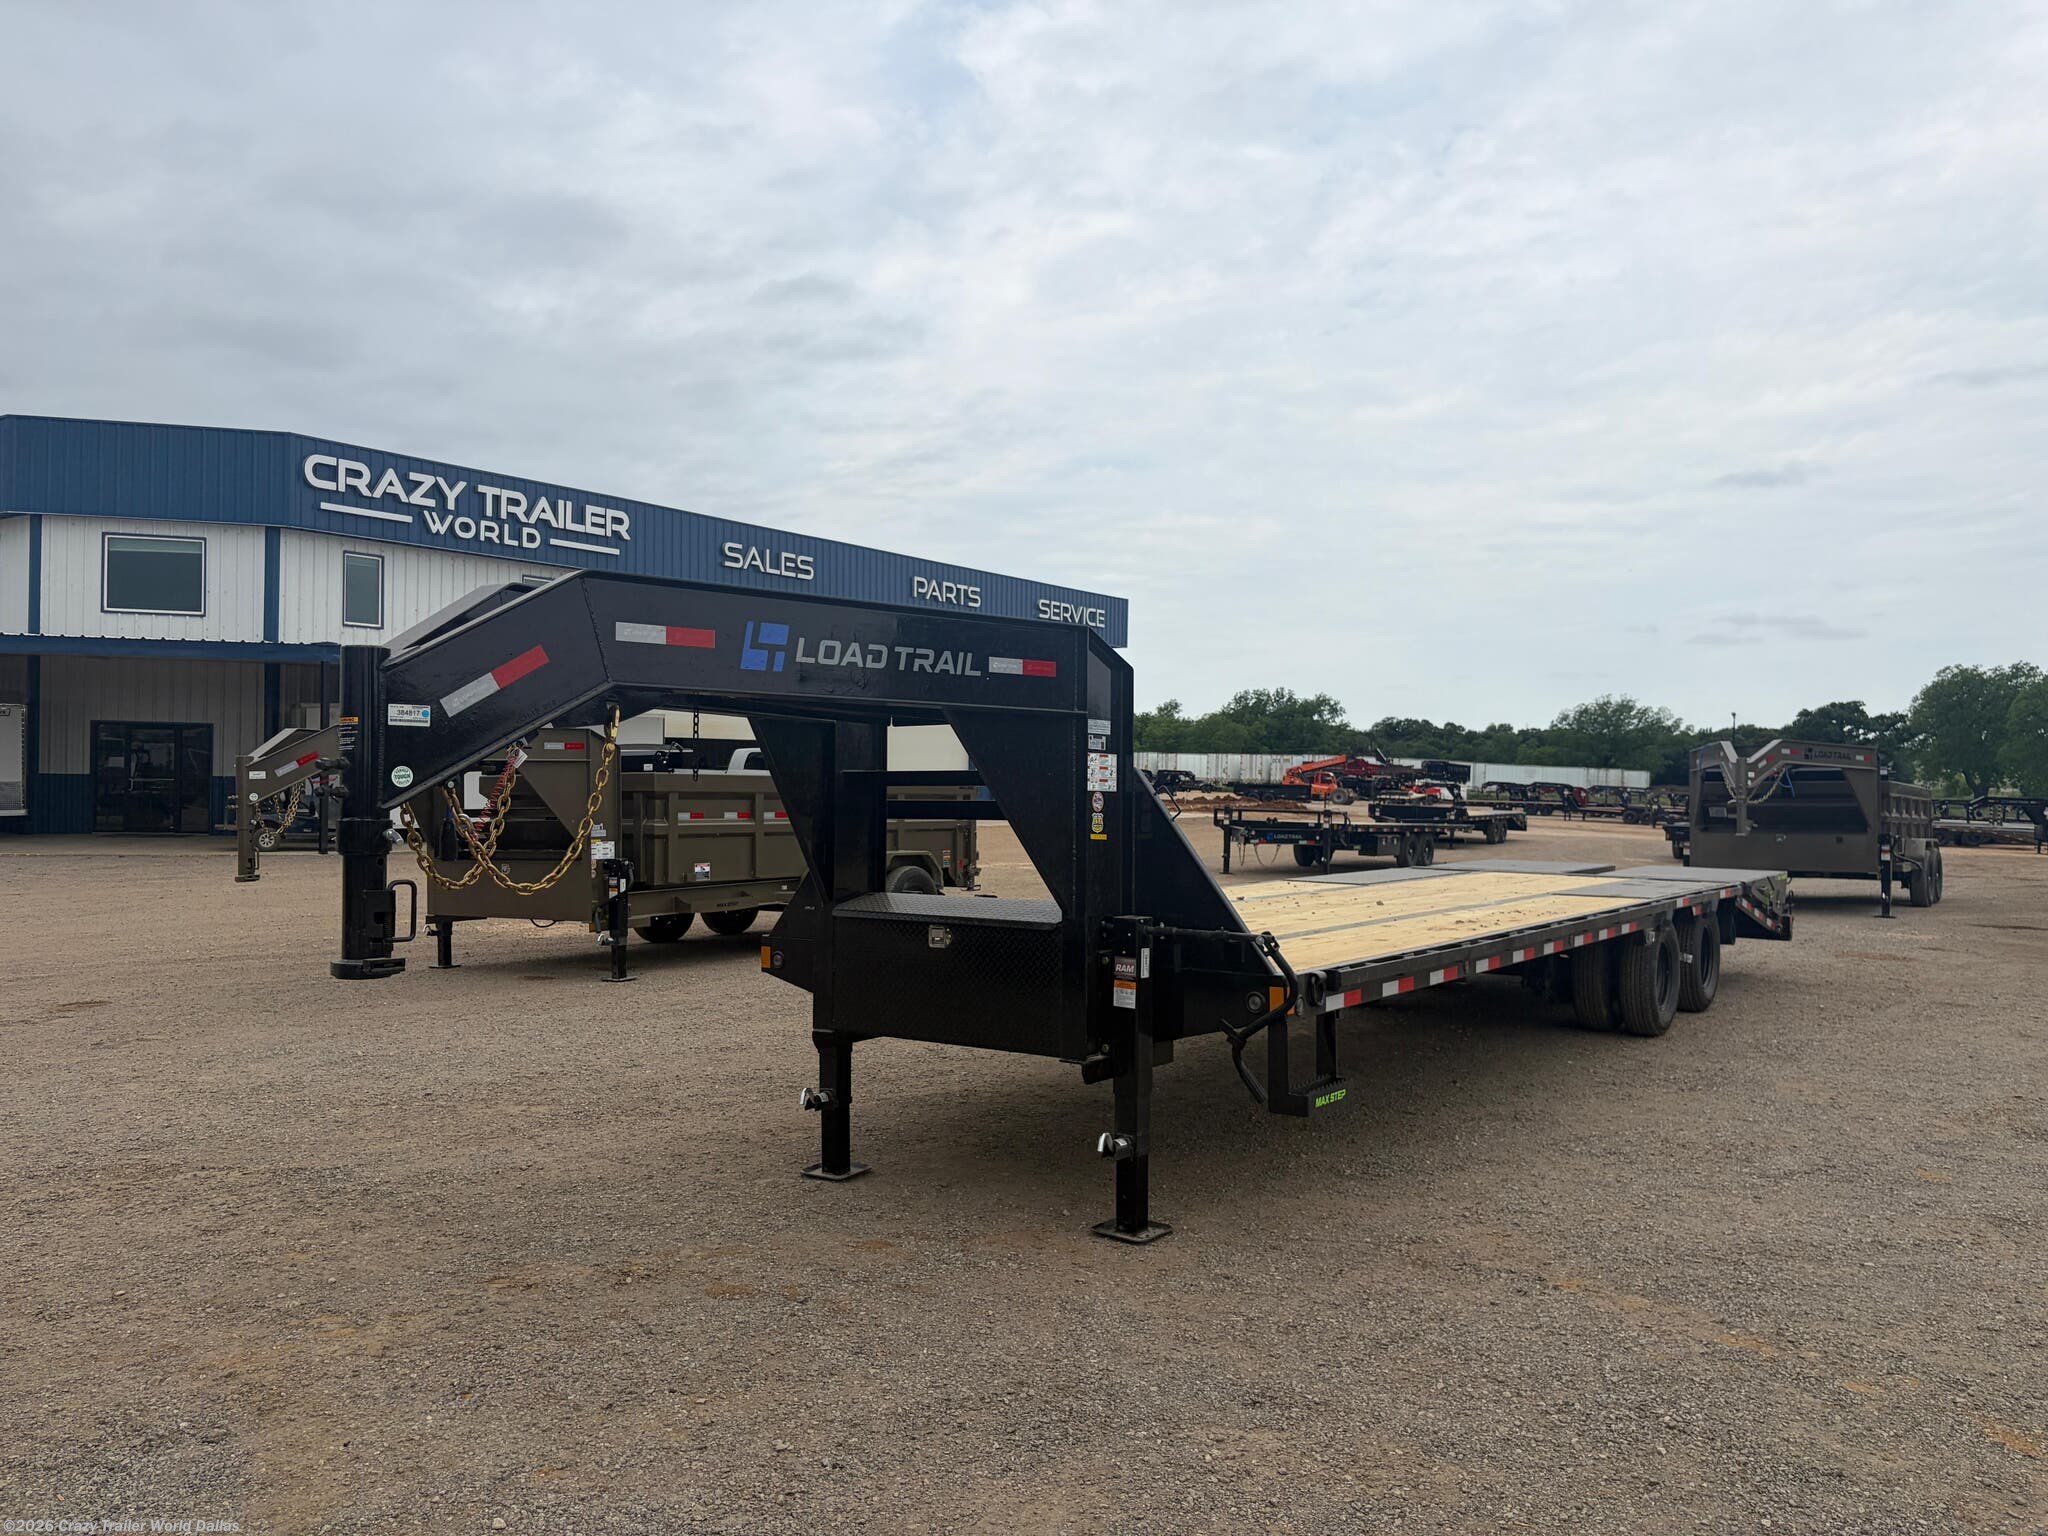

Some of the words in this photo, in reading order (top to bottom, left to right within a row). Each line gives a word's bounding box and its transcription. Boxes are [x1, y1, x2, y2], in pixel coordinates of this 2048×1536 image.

[304, 454, 467, 510] CRAZY
[477, 484, 631, 540] TRAILER
[423, 510, 541, 549] WORLD
[722, 541, 814, 580] SALES
[913, 576, 981, 608] PARTS
[1038, 599, 1105, 628] SERVICE
[796, 637, 888, 669] LOAD
[894, 647, 981, 677] TRAIL
[1115, 963, 1135, 974] RAM
[1315, 1094, 1330, 1108] MAX
[1330, 1089, 1346, 1103] STEP
